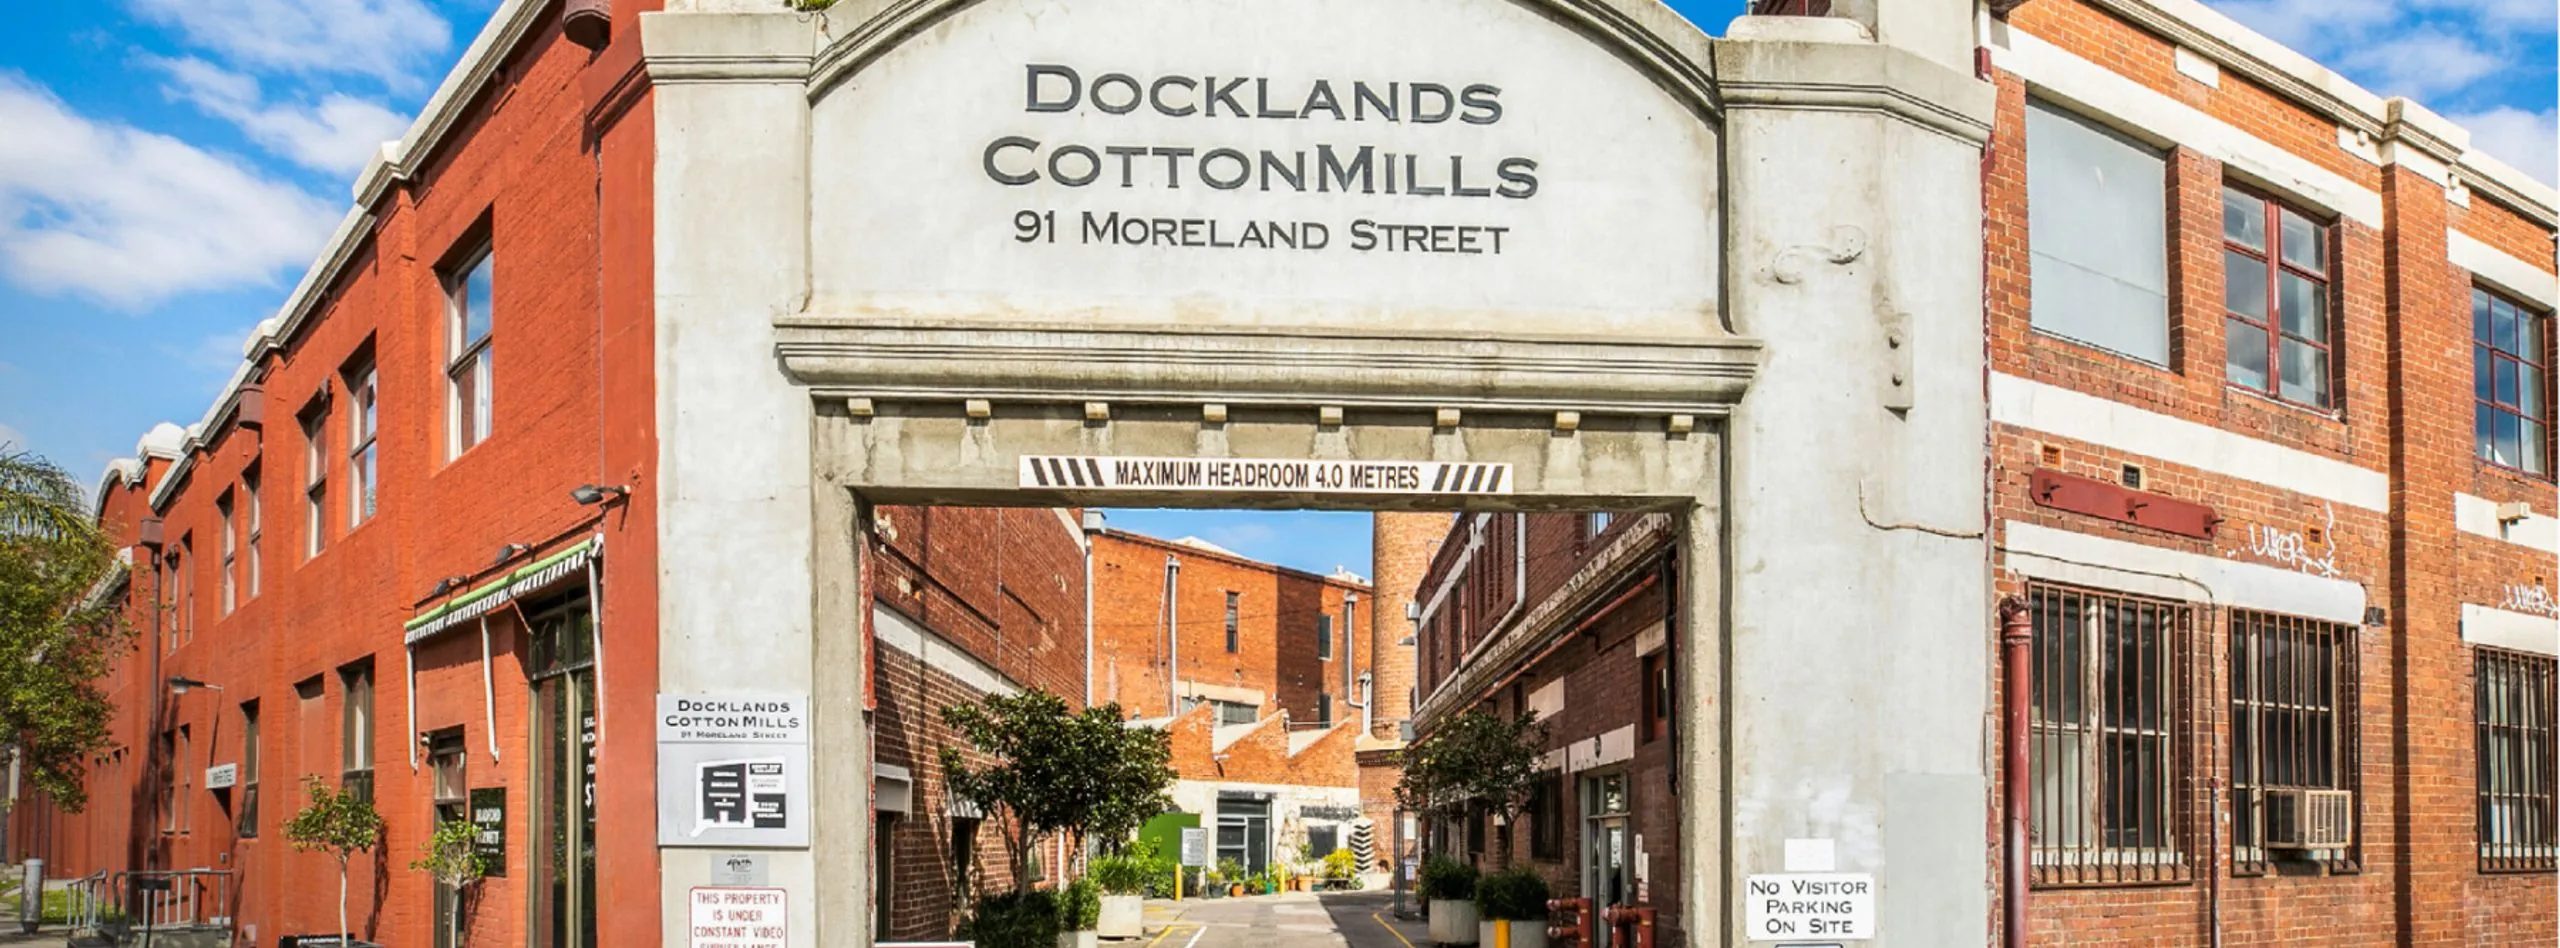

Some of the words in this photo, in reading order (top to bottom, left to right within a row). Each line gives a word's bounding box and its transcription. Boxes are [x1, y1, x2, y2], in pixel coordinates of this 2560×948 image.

[1025, 63, 1503, 125] DOCKLANDS
[1014, 209, 1055, 243] 91
[1081, 211, 1329, 249] MORELAND
[1350, 218, 1510, 255] STREET
[1115, 461, 1201, 486] MAXIMUM
[1208, 463, 1309, 488] HEADROOM
[1315, 465, 1343, 487] 4.0
[1350, 465, 1419, 489] METRES
[678, 699, 791, 713] DOCKLANDS
[1751, 880, 1780, 895] NO
[1791, 880, 1868, 895] VISITOR
[697, 892, 720, 904] THIS
[724, 893, 779, 905] PROPERTY
[1766, 899, 1853, 914] PARKING
[713, 909, 724, 921] IS
[728, 910, 763, 921] UNDER
[694, 926, 747, 938] CONSTANT
[753, 927, 784, 939] VIDEO
[1766, 918, 1796, 934] ON
[1809, 918, 1854, 934] SITE
